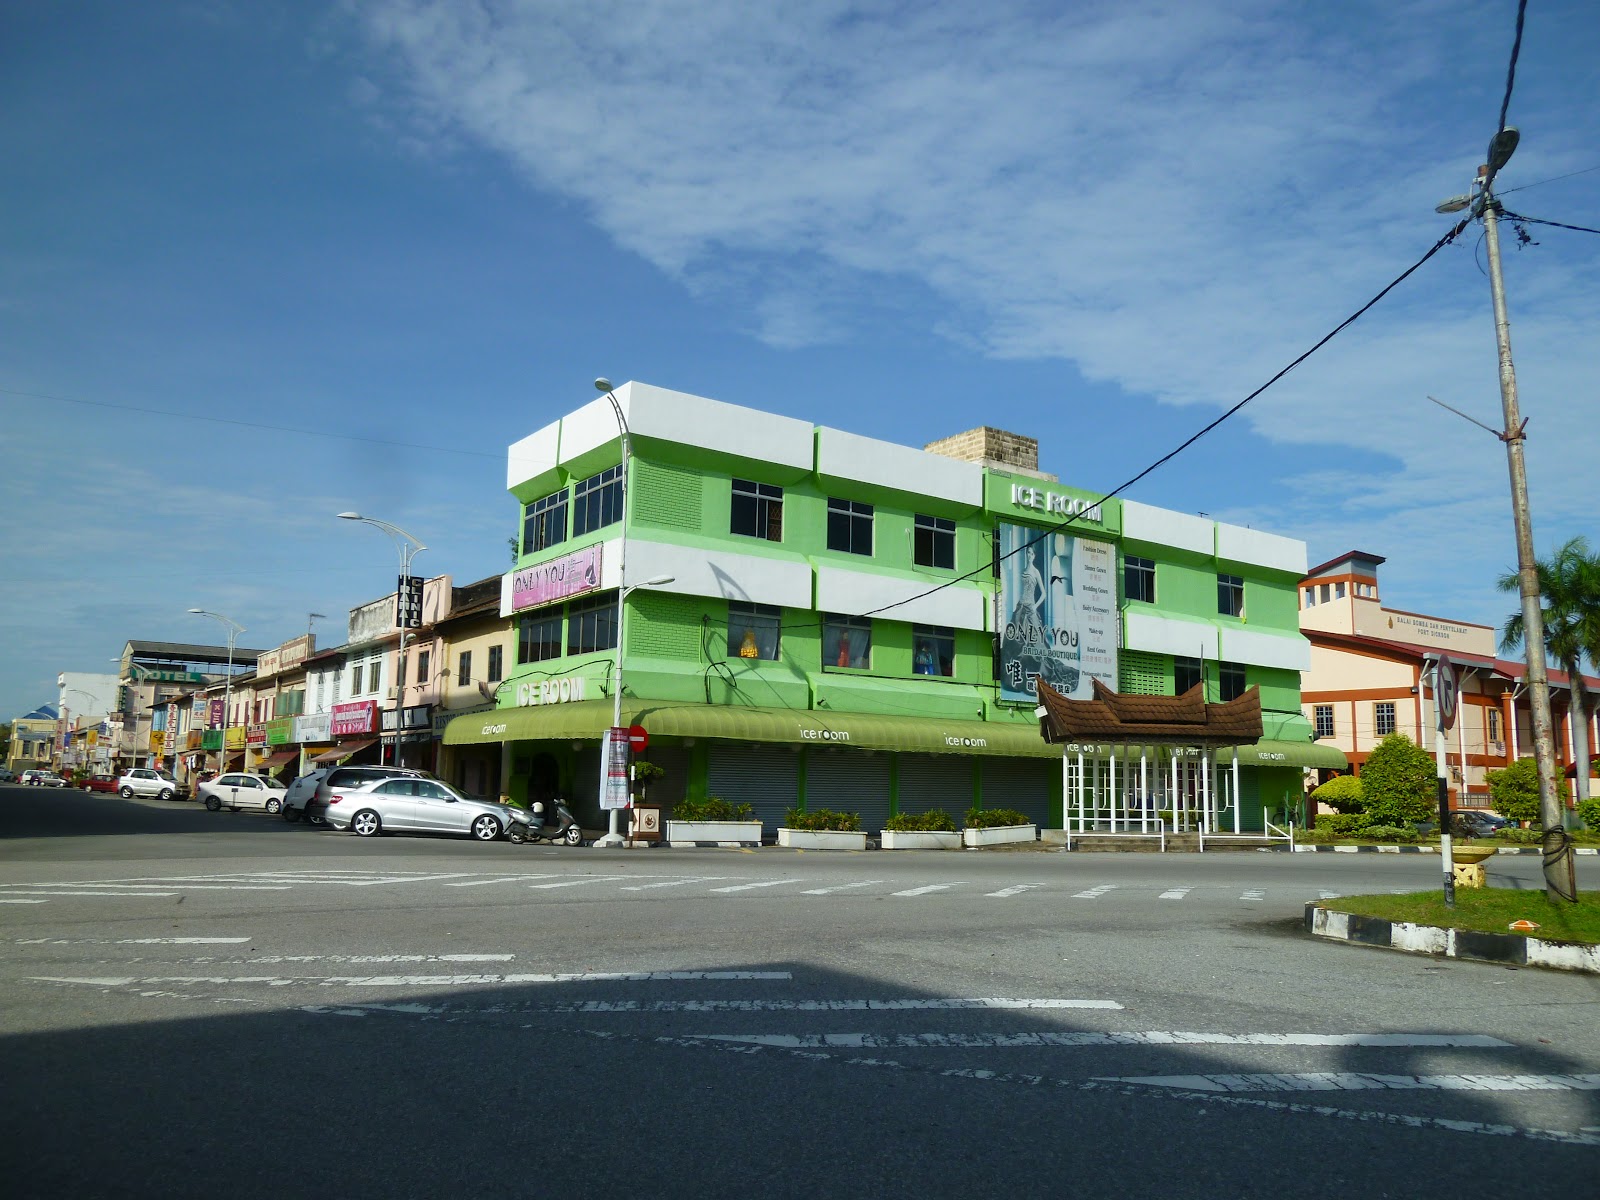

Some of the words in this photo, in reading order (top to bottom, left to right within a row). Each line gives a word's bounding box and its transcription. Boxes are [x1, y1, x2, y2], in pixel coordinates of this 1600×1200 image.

[1011, 483, 1044, 509] ICE
[1046, 491, 1102, 521] ROOM
[515, 570, 543, 594] ONLY
[545, 563, 565, 583] YOU
[1096, 566, 1107, 574] Gown
[1098, 586, 1108, 594] Gown
[410, 579, 422, 628] CLINIC
[1092, 605, 1110, 615] Accessory
[1006, 622, 1048, 645] ONLY
[1051, 627, 1079, 648] YOU
[1418, 628, 1429, 636] PORT
[1023, 646, 1047, 657] BRIDAL
[1048, 649, 1078, 660] BOUTIQUE
[141, 669, 197, 682] OTEL
[1006, 660, 1041, 687] 唯一
[517, 681, 540, 707] ICE
[541, 676, 585, 705] ROOM
